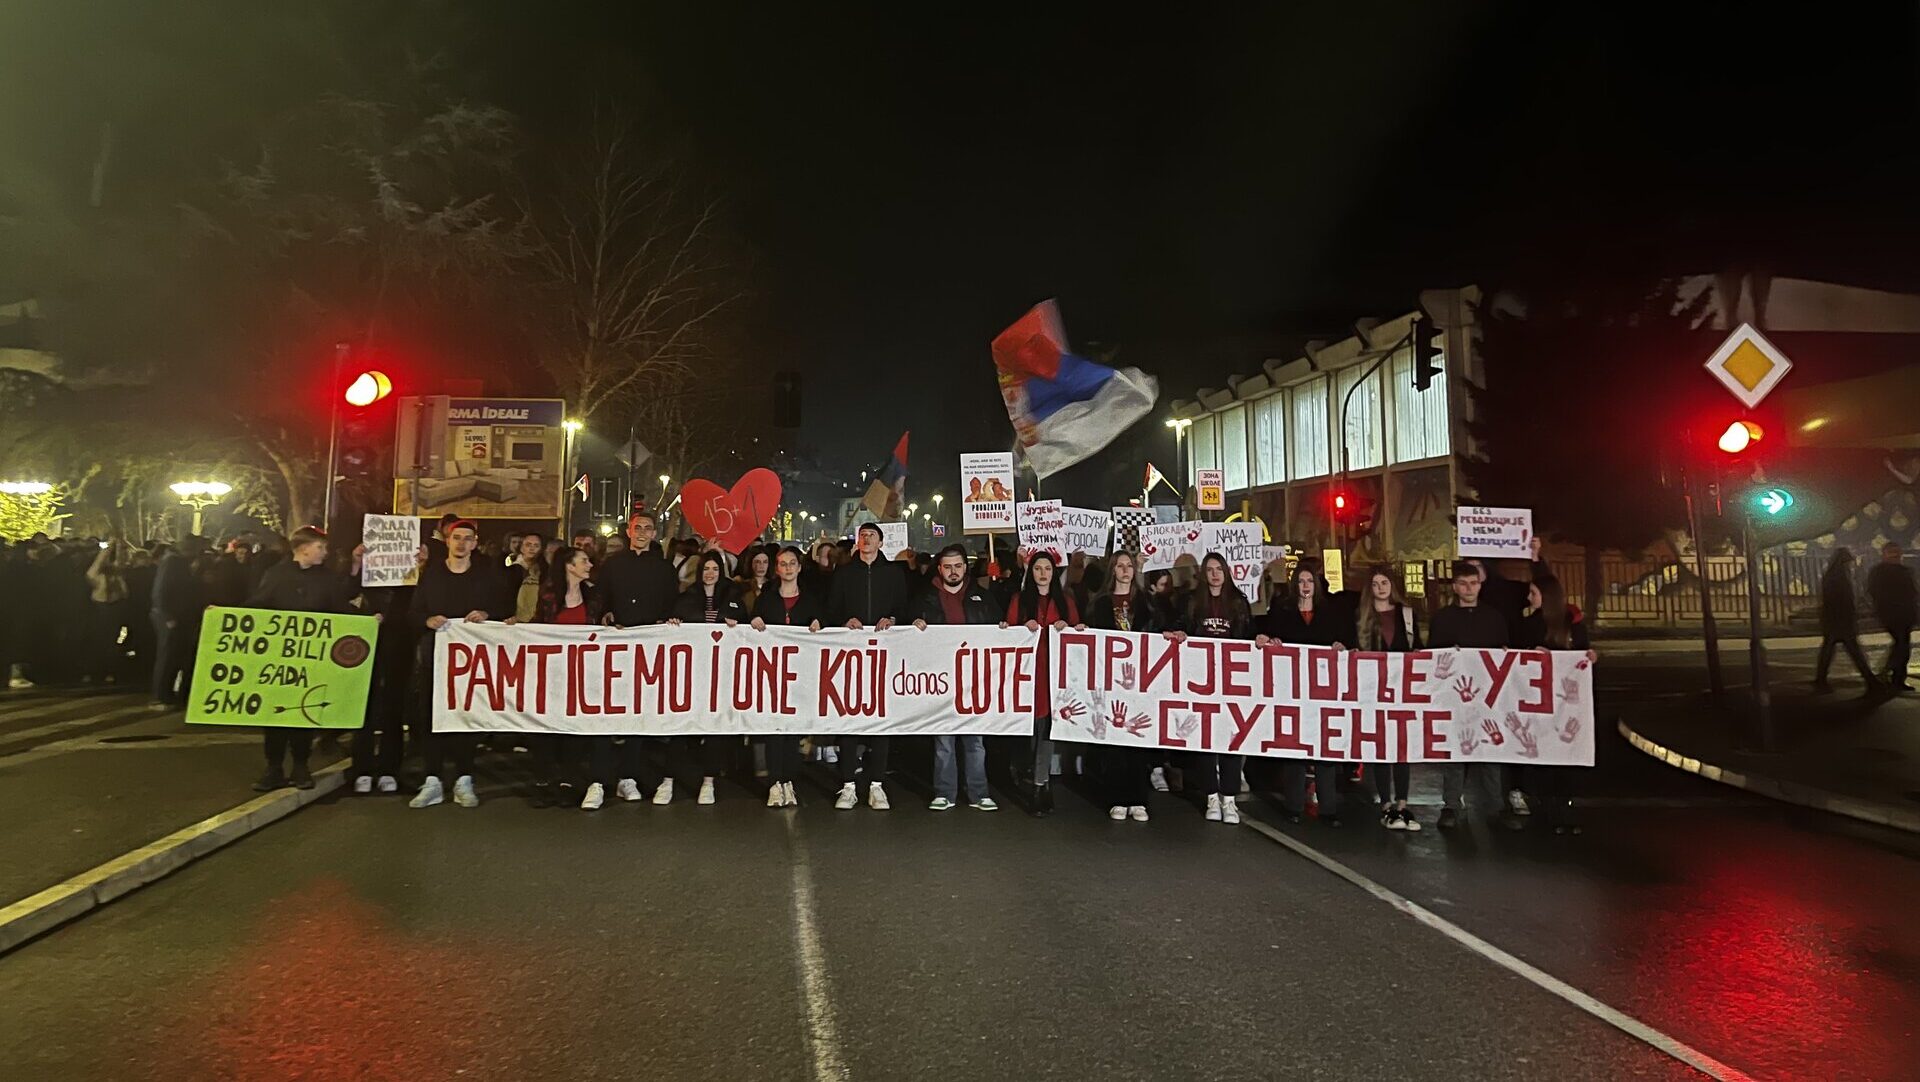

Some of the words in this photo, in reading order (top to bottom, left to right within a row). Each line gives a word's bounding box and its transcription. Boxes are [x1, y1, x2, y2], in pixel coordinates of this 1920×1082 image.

[448, 408, 480, 419] RMA
[482, 406, 530, 420] IDEALE
[704, 485, 760, 534] 15+1
[1020, 523, 1036, 532] КАКО
[1472, 526, 1502, 535] НЕМА
[220, 613, 255, 634] DO
[263, 614, 332, 639] SADA
[216, 634, 269, 655] SMO
[281, 637, 327, 661] BILI
[210, 663, 244, 685] OD
[258, 663, 309, 688] SADA
[447, 632, 693, 717] PAMTIĆEMO
[732, 645, 800, 715] ONE
[818, 639, 888, 718] KOJI
[892, 658, 950, 697] danas
[953, 641, 1035, 716] ĆUTE
[1058, 633, 1433, 704] ПРИЈЕПОЉЕ
[1479, 650, 1554, 715] УЗ
[203, 688, 263, 716] SMO
[1158, 700, 1452, 763] СТУДЕНТЕ
